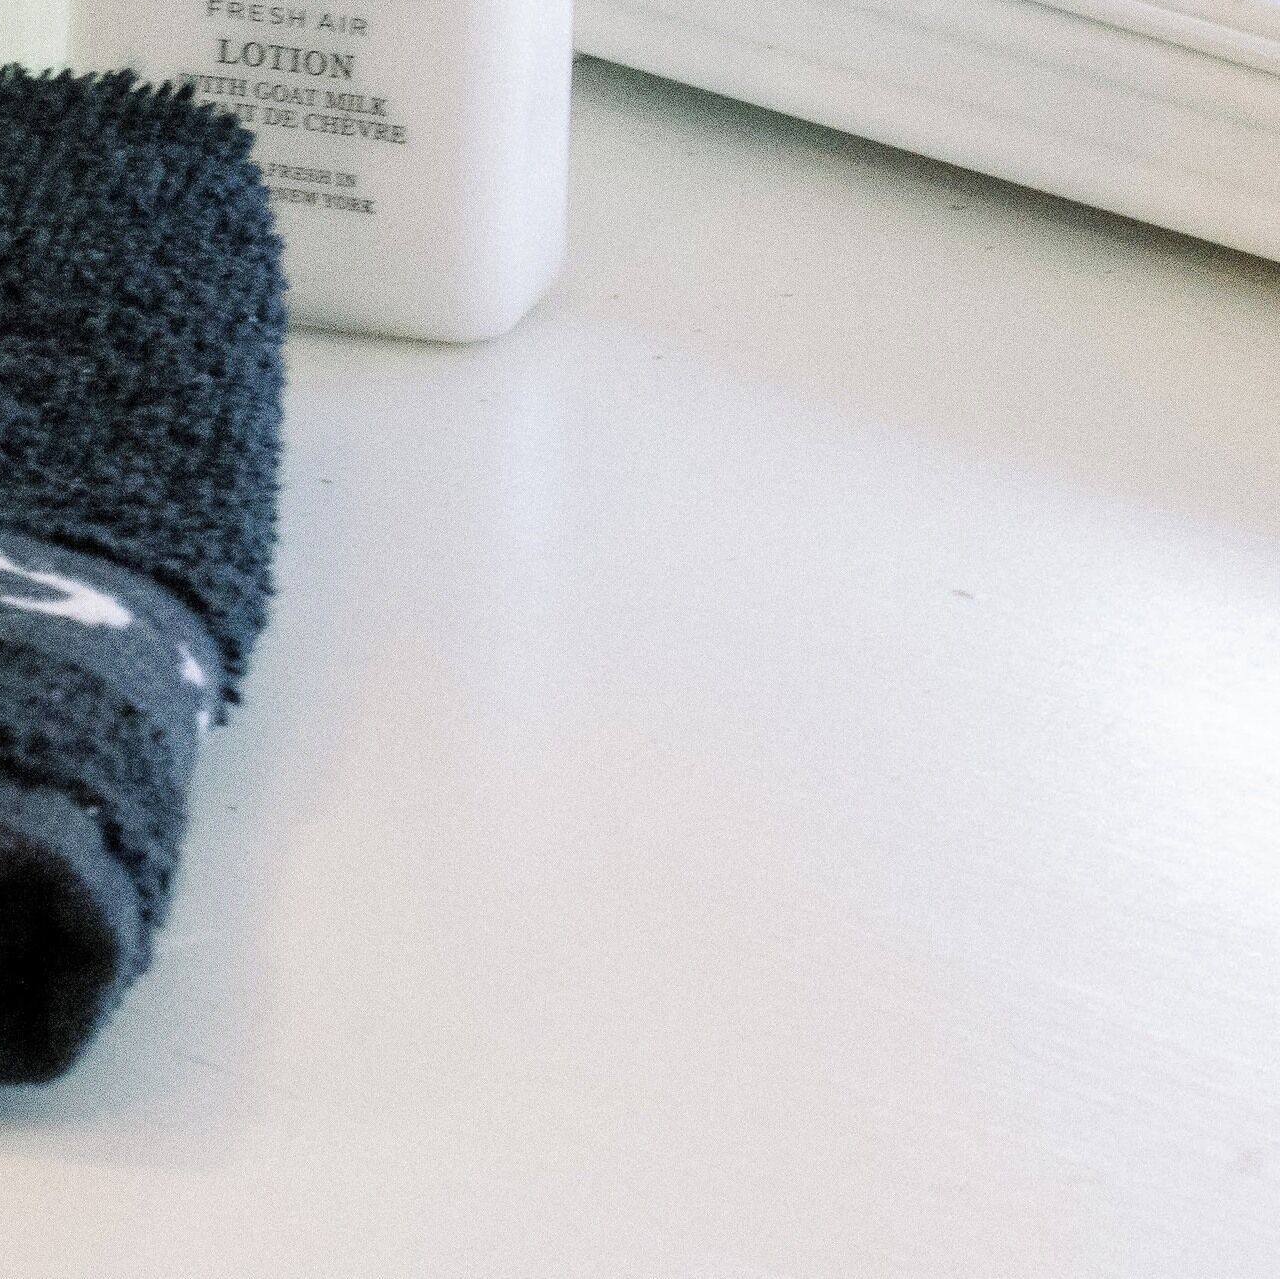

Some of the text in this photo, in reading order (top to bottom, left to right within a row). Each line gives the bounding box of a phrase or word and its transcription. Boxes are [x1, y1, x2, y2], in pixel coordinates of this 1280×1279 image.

[206, 0, 369, 37] FRESH AIR
[216, 37, 356, 81] LOTION
[253, 81, 318, 108] GOAT
[322, 90, 388, 118] MILK
[262, 106, 299, 129] DE
